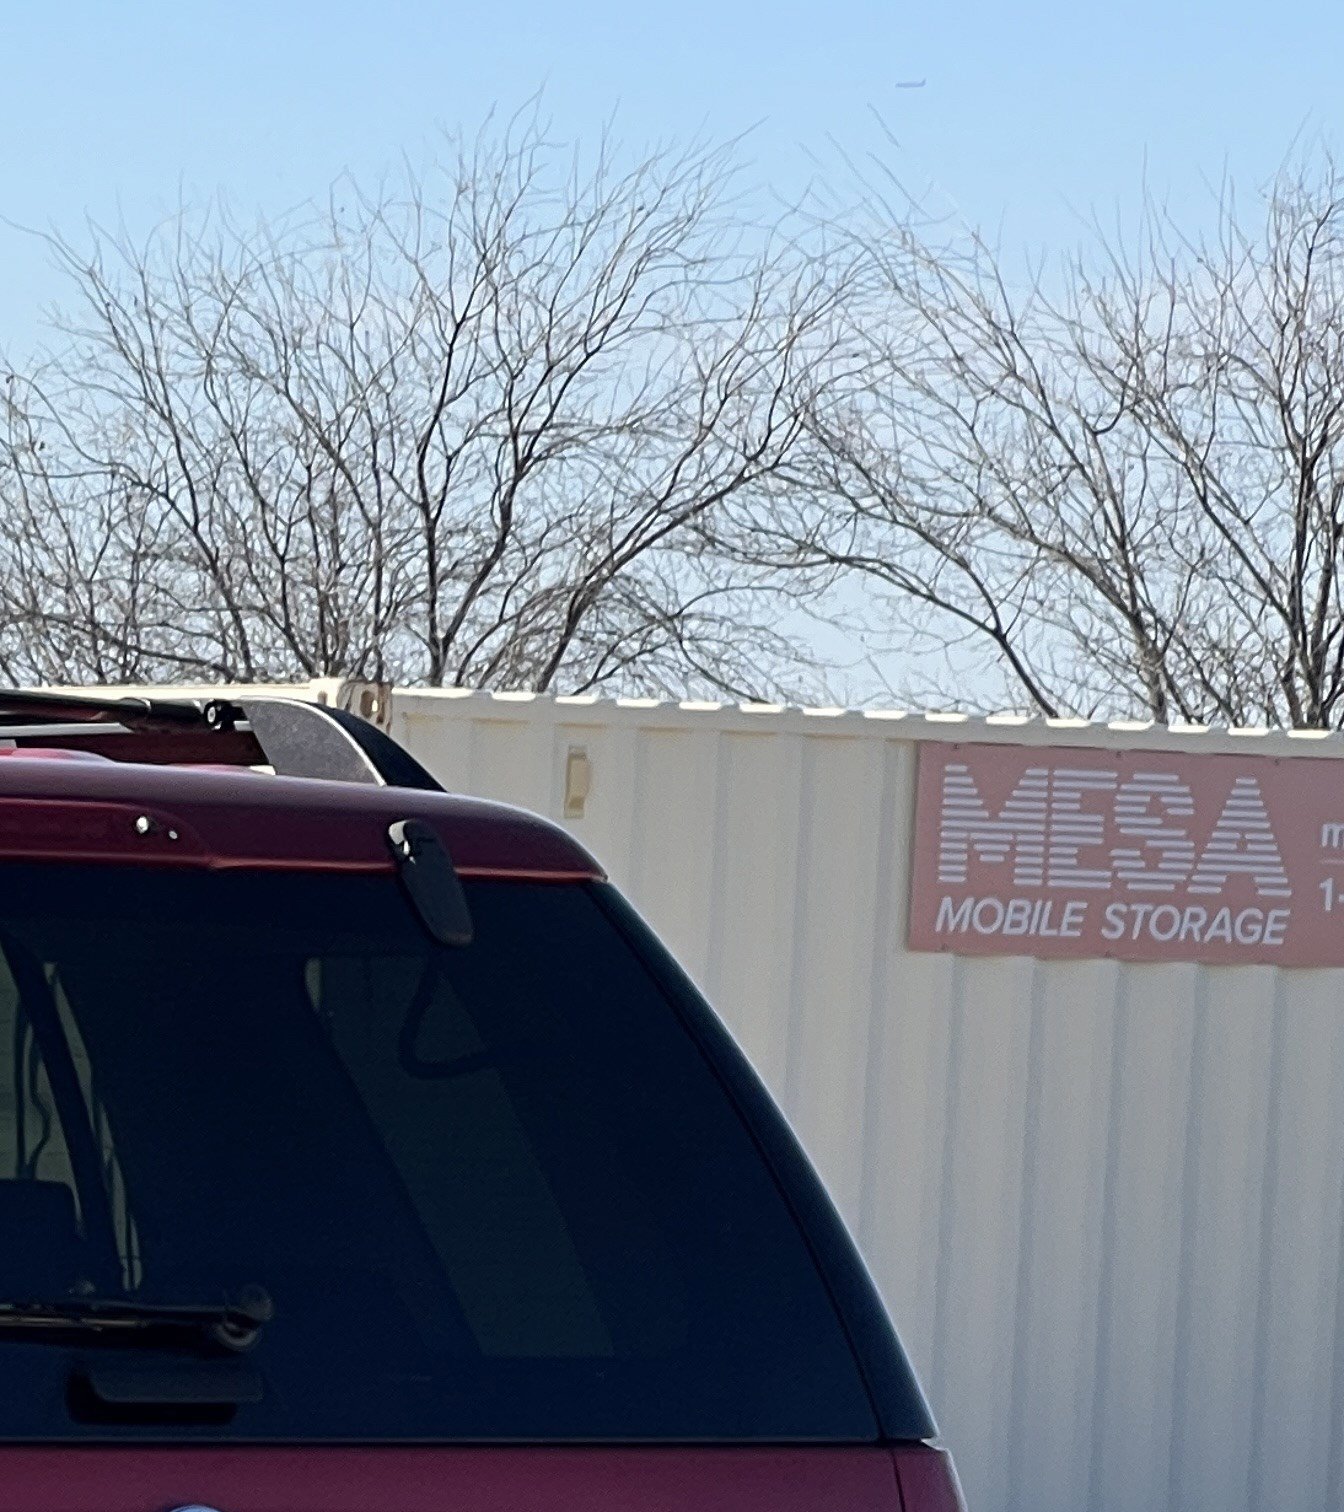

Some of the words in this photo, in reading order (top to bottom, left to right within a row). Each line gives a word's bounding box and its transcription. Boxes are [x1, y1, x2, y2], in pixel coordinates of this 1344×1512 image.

[938, 764, 1292, 896] MESA
[935, 896, 1088, 938] MOBILE
[1101, 903, 1292, 945] STORAGE
